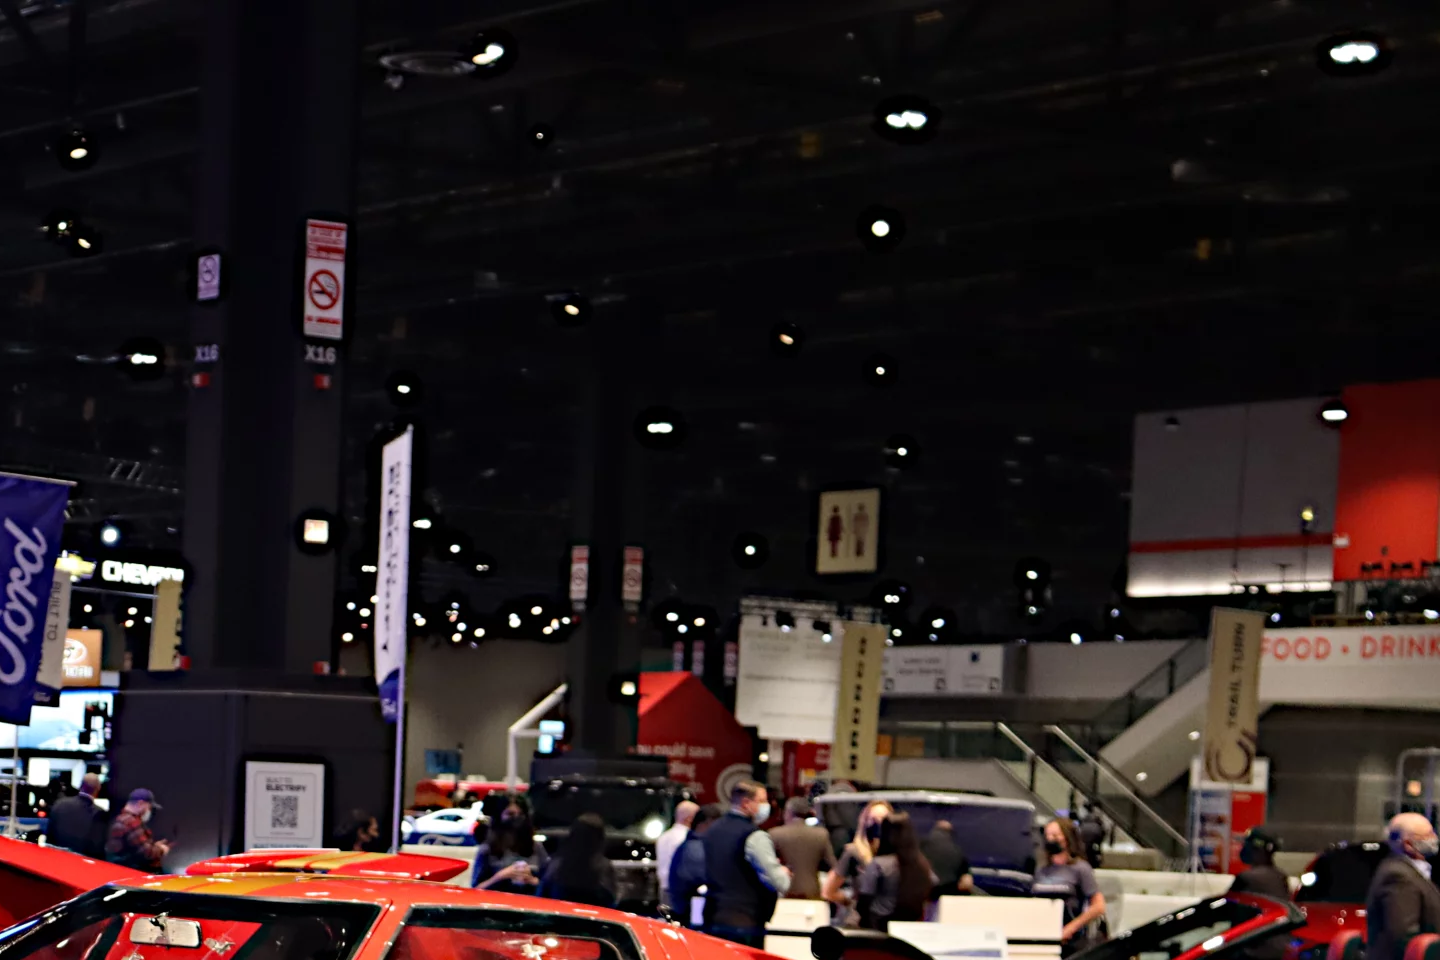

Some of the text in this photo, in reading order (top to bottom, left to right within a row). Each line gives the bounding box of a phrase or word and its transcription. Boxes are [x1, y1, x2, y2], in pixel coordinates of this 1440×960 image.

[305, 345, 337, 364] X16
[47, 580, 63, 641] BUILT TO
[1260, 634, 1440, 661] FOOD DRINK
